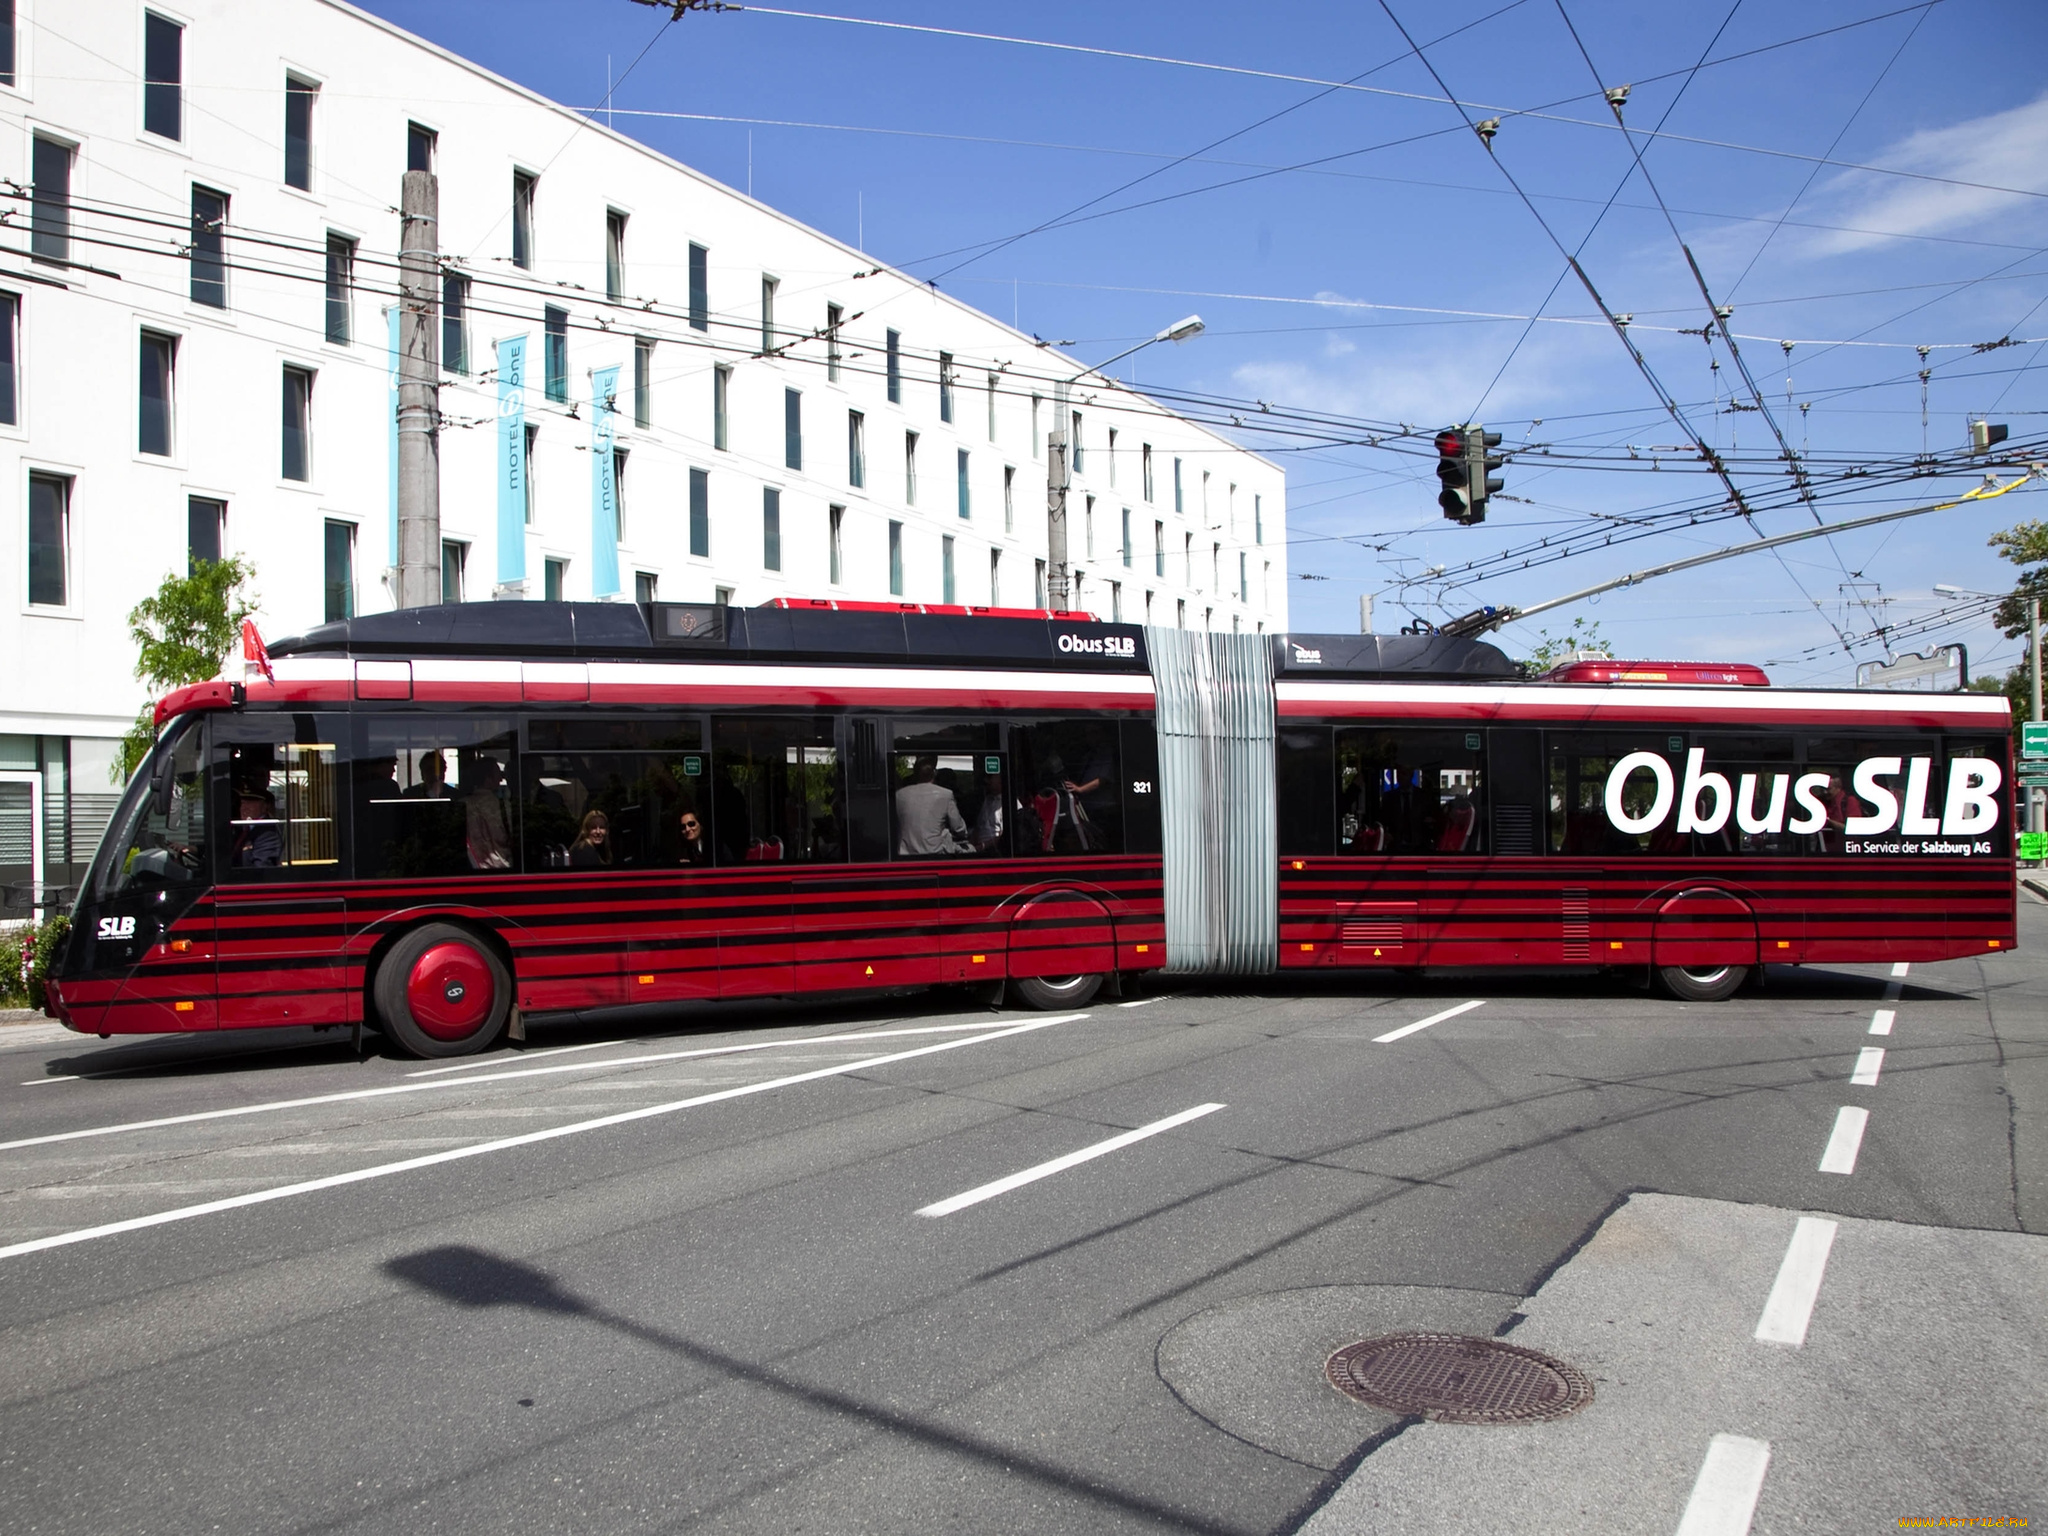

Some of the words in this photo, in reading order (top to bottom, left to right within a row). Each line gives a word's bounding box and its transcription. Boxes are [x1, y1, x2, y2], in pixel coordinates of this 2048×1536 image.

[1058, 633, 1103, 653] Obus
[1104, 636, 1136, 654] SLB
[1133, 781, 1152, 794] 321
[1604, 747, 1831, 835] Obus
[1844, 757, 2002, 835] SLB
[1845, 841, 1861, 854] Ein
[1863, 841, 1900, 854] Service
[1901, 841, 1920, 854] der
[1921, 841, 1971, 857] Salzburg
[1973, 841, 1992, 854] AG
[97, 916, 136, 937] SLB
